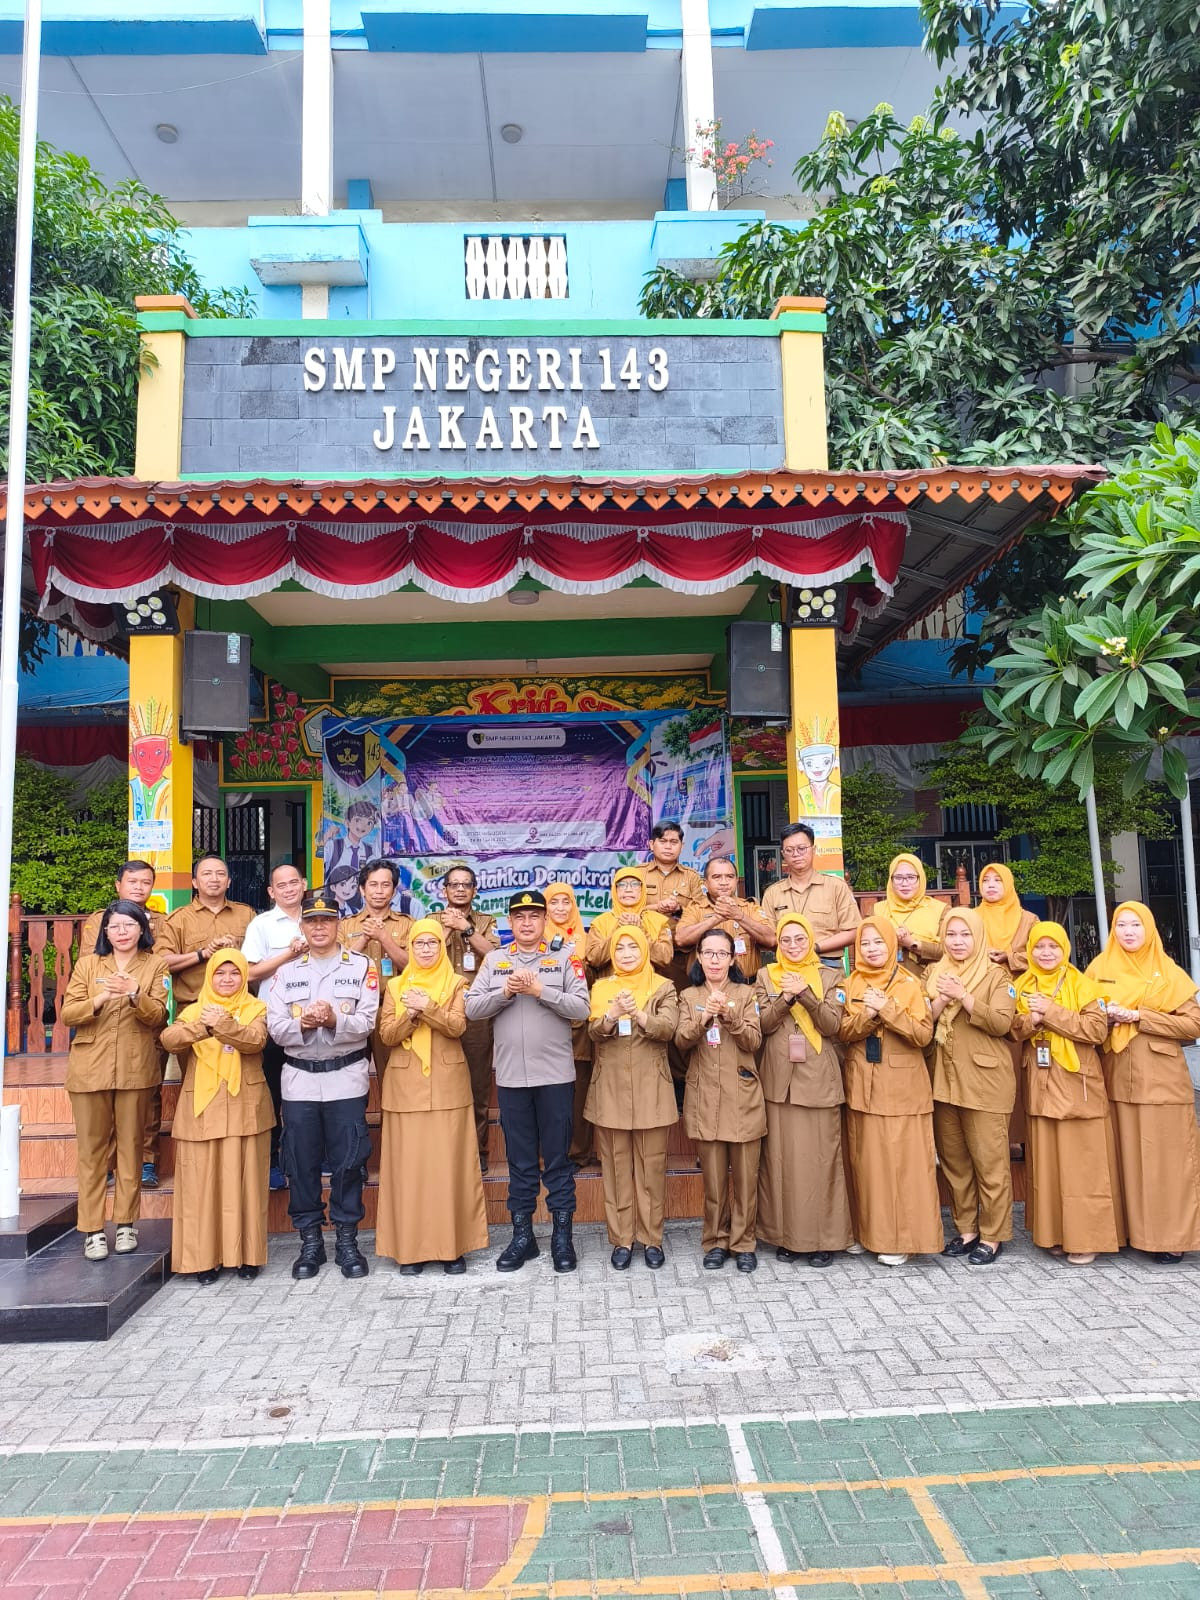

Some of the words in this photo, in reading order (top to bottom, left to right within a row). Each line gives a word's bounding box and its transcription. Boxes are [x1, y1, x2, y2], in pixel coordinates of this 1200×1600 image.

[303, 346, 397, 393] SMP
[412, 346, 584, 393] NEGERI
[598, 346, 670, 392] 143
[372, 405, 601, 451] JAKARTA
[429, 864, 450, 876] Tem
[533, 866, 617, 888] Demokrat
[539, 966, 562, 974] POLRI
[335, 978, 360, 987] POLRI
